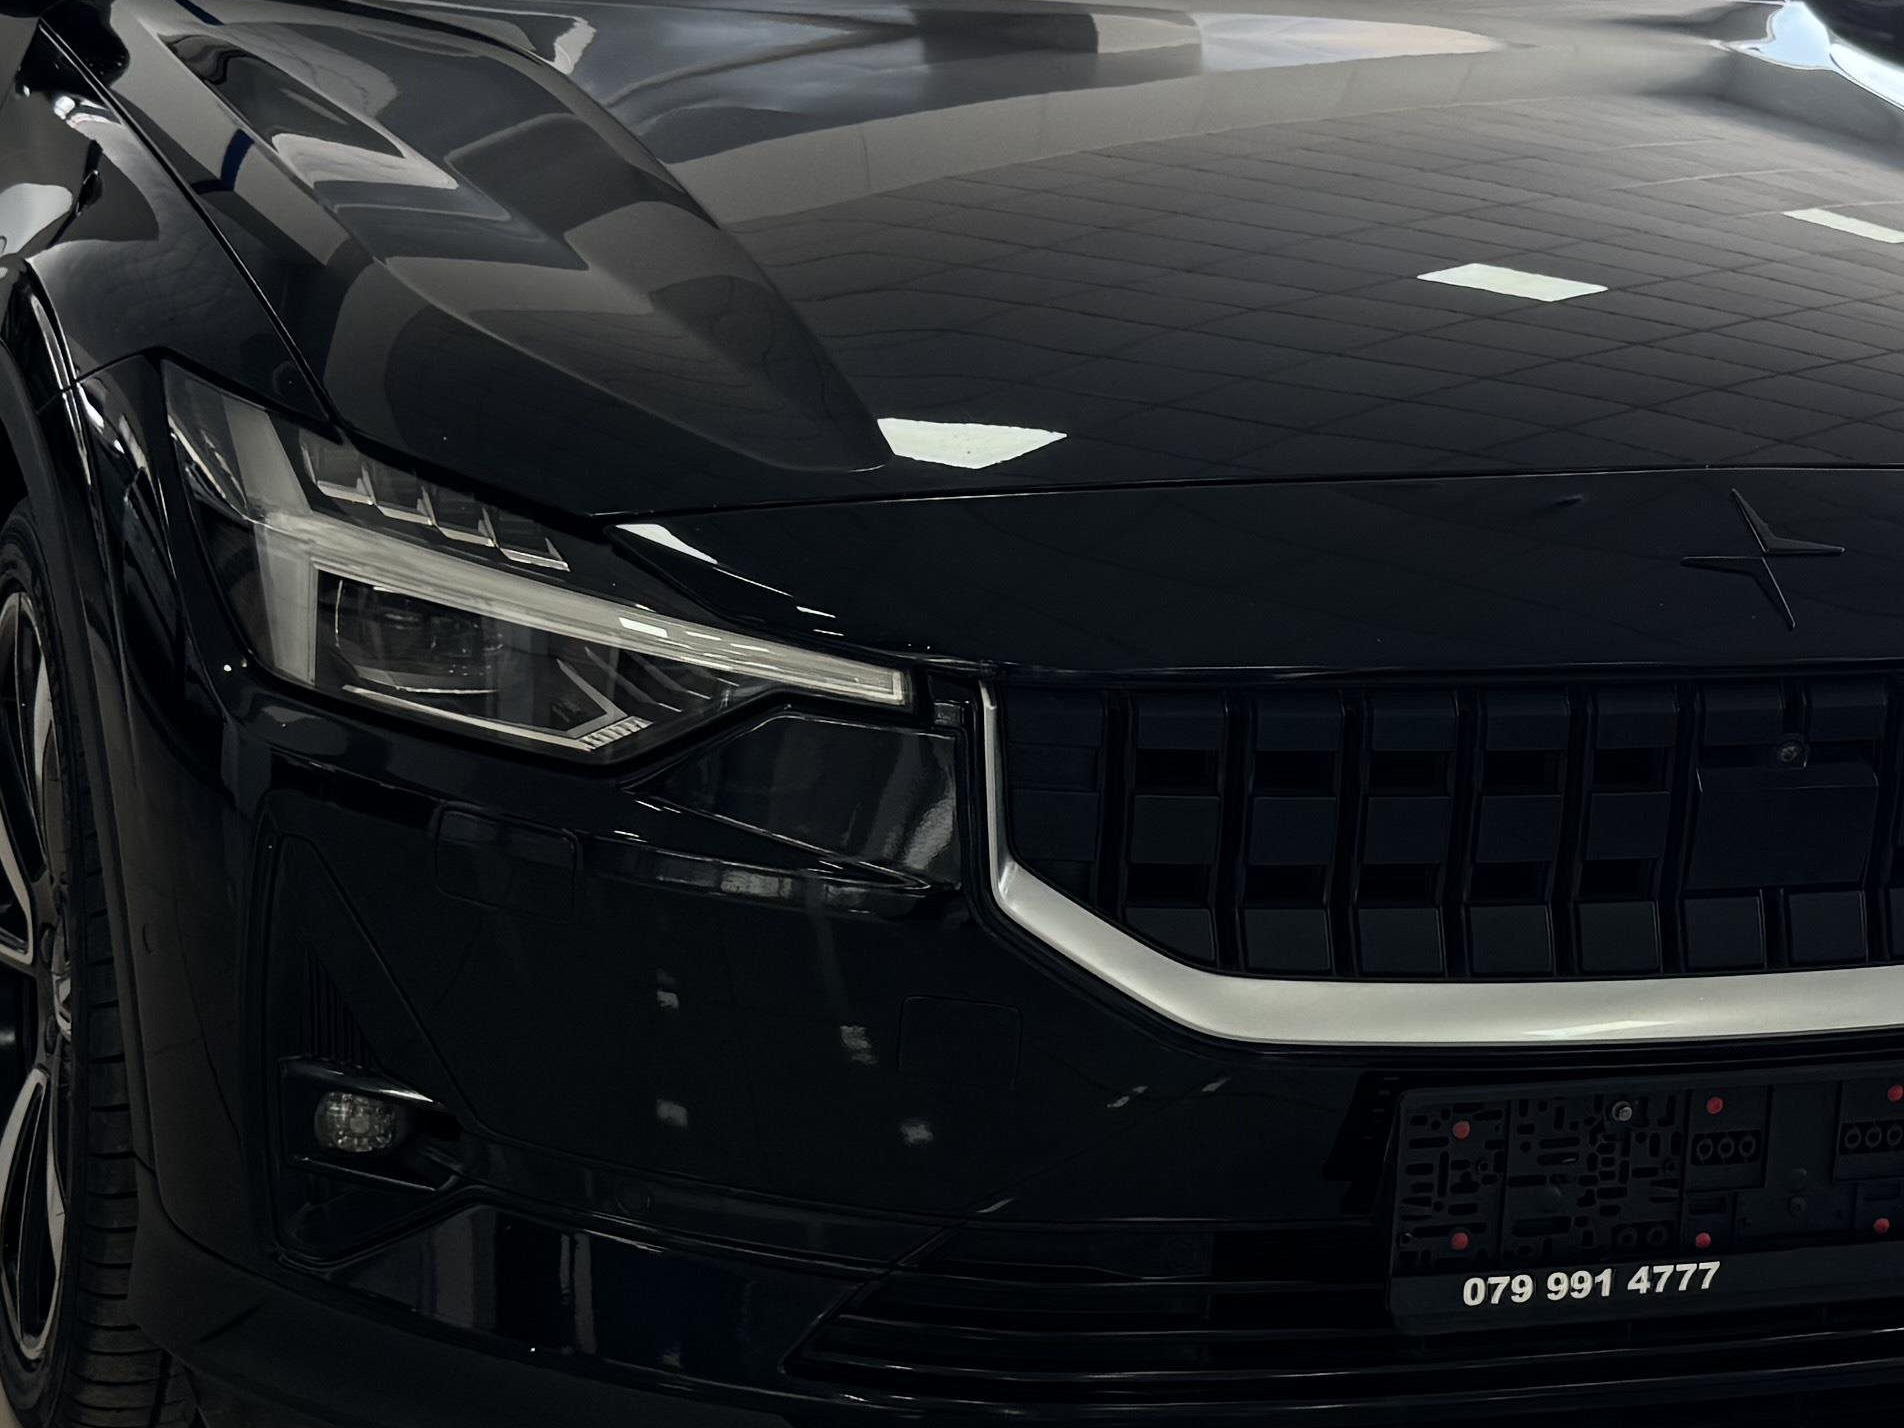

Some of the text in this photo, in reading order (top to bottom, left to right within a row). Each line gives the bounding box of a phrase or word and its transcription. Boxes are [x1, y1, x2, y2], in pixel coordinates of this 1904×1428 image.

[1463, 1261, 1721, 1307] 079 991 4777
